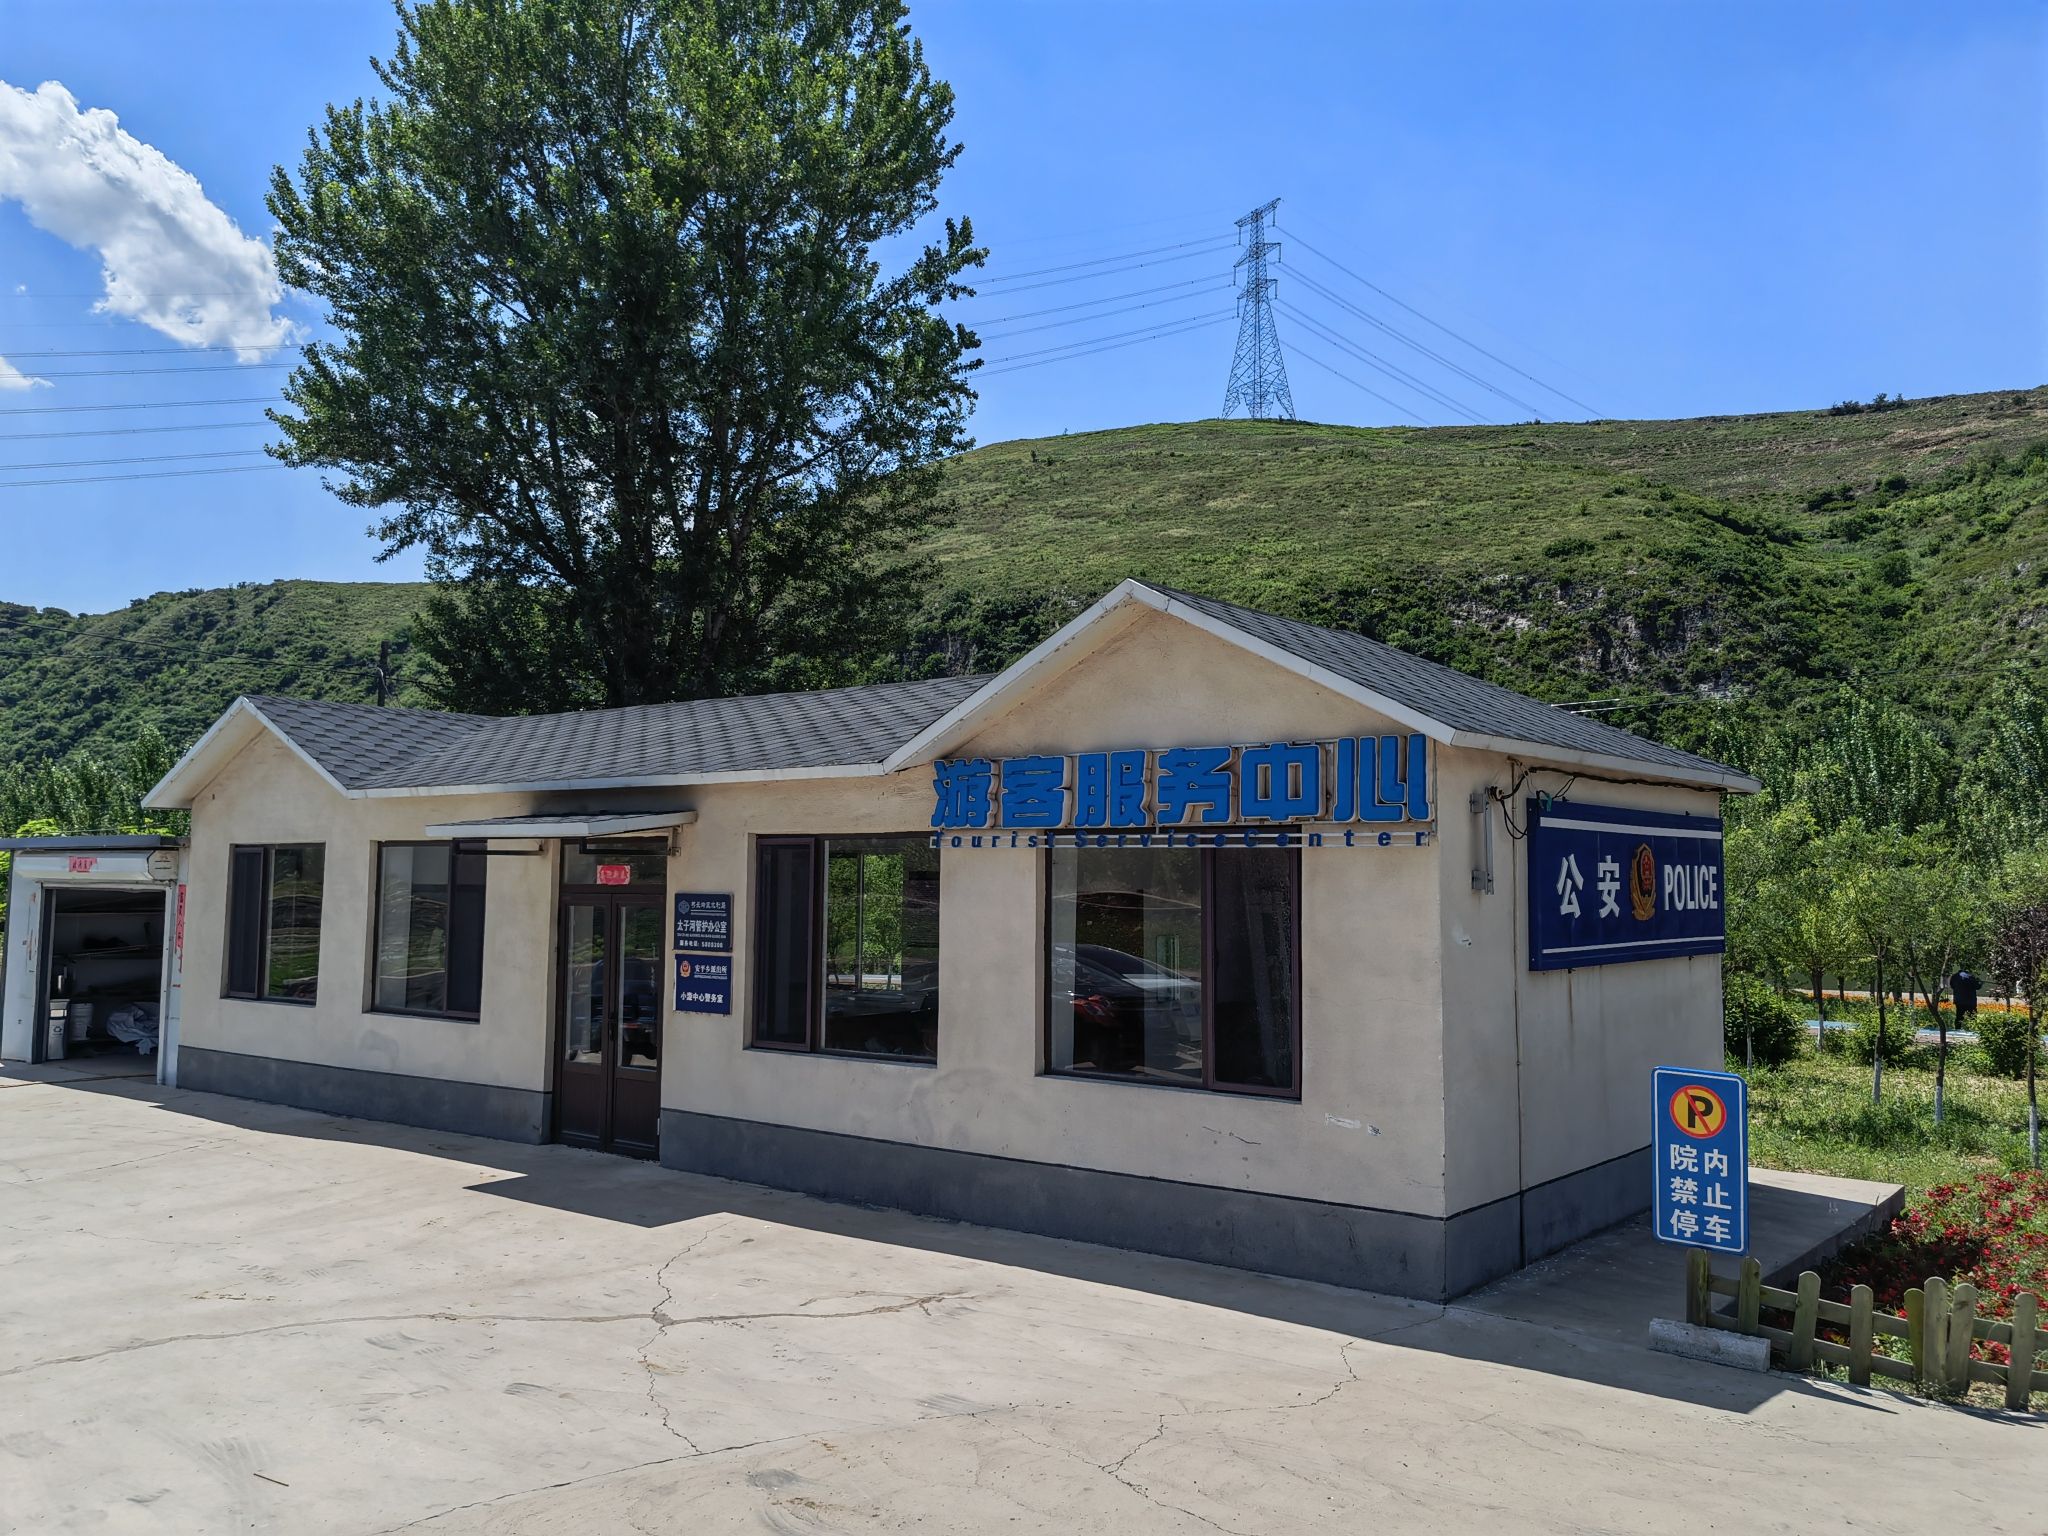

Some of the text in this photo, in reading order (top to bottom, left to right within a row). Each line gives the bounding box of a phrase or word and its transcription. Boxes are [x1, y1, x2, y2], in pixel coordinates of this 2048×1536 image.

[932, 733, 1431, 829] 游客服务中心
[935, 828, 1430, 849] Tourist Service Center
[1556, 853, 1718, 919] 公安 POLICE
[1669, 1143, 1729, 1178] 院内
[1670, 1175, 1732, 1211] 禁止
[1669, 1208, 1732, 1244] 停车
